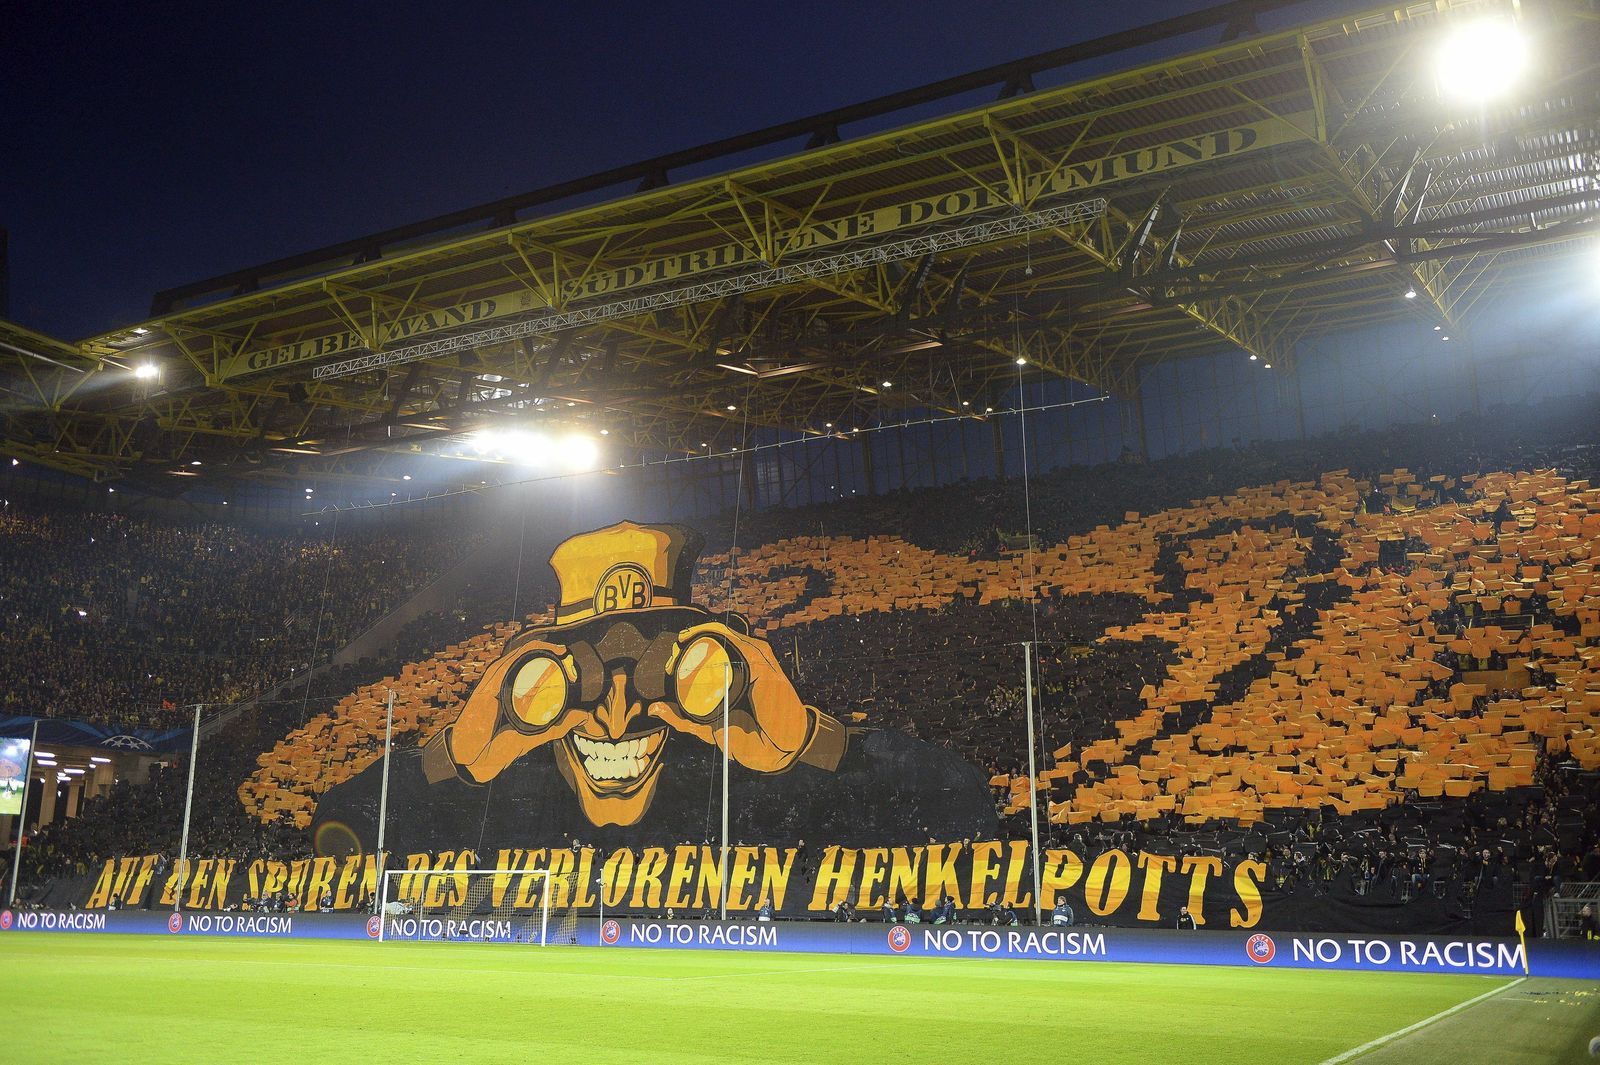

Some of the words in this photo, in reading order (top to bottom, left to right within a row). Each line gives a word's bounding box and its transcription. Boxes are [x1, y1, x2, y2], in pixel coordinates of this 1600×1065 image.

[248, 331, 363, 370] GELBE
[384, 300, 497, 339] WAND
[897, 127, 1258, 227] DORTMUND
[603, 574, 646, 611] BVB
[85, 854, 159, 909] AUF
[160, 858, 237, 910] DEN
[242, 852, 388, 911] SPUREN
[398, 850, 475, 907] DES
[492, 845, 798, 911] VERLORENEN
[807, 840, 1267, 929] HENKELPOTTS
[17, 912, 38, 928] NO
[40, 913, 57, 929] TO
[58, 913, 106, 929] RACISM
[188, 915, 212, 931] NO
[214, 916, 234, 932] TO
[236, 916, 292, 933] RACISM
[390, 919, 417, 936] NO
[420, 919, 443, 937] TO
[447, 920, 511, 939] RACISM
[630, 923, 662, 943] NO
[666, 924, 693, 944] TO
[698, 925, 778, 946] RACISM
[924, 930, 962, 951] NO
[967, 931, 1001, 952] TO
[1008, 931, 1107, 955] RACISM
[1293, 938, 1342, 962] NO
[1347, 939, 1391, 965] TO
[1400, 941, 1527, 969] RACISM
